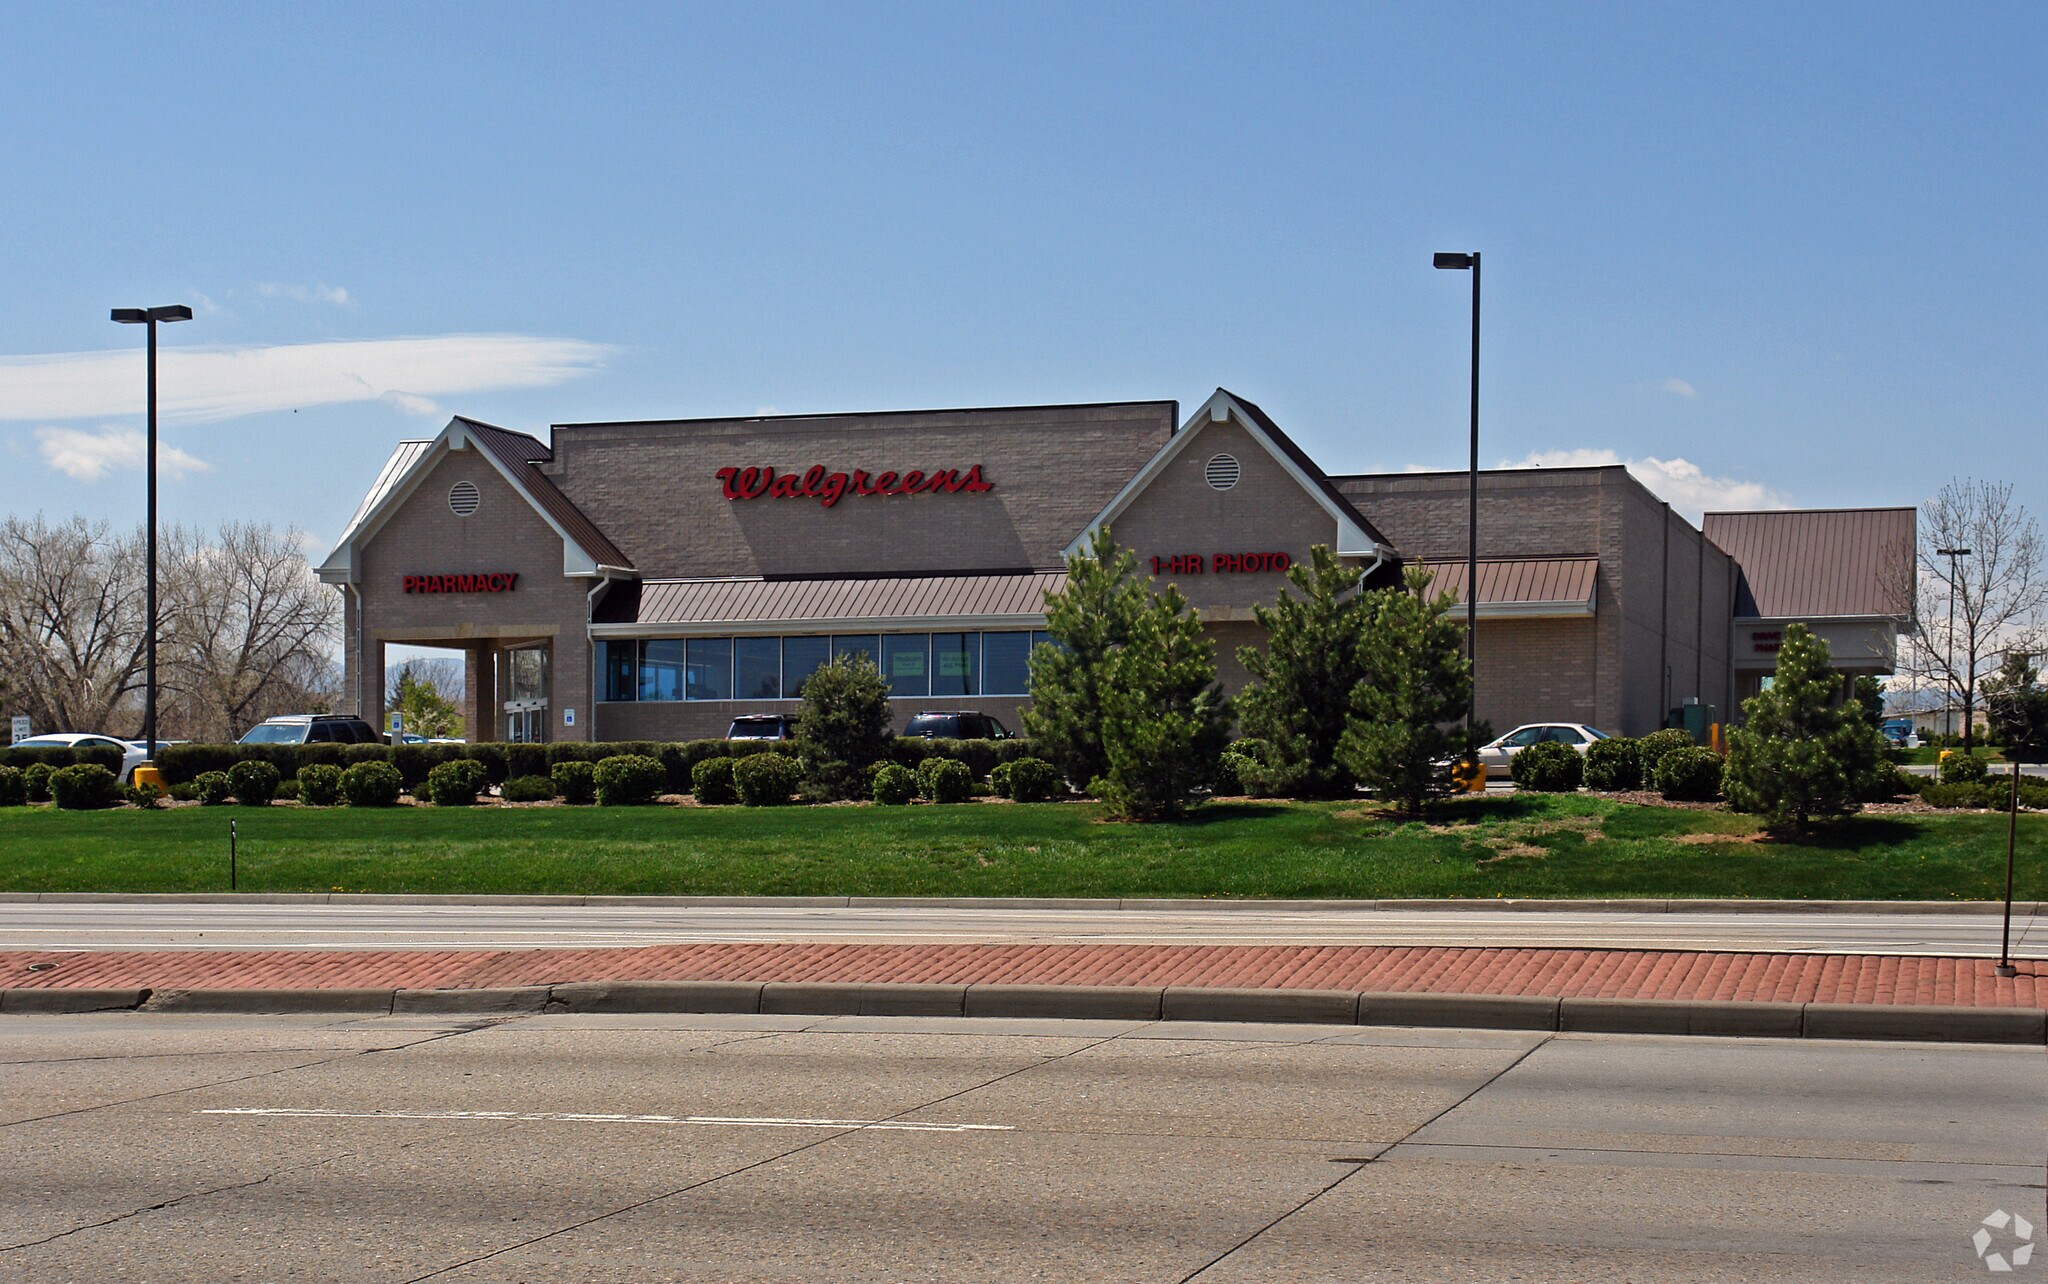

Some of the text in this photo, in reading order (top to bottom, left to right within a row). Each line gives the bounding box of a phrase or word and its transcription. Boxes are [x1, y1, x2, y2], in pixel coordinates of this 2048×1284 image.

[715, 464, 995, 508] Walgreens
[1150, 552, 1290, 575] 1-HR PHOTO
[402, 573, 518, 594] PHARMACY
